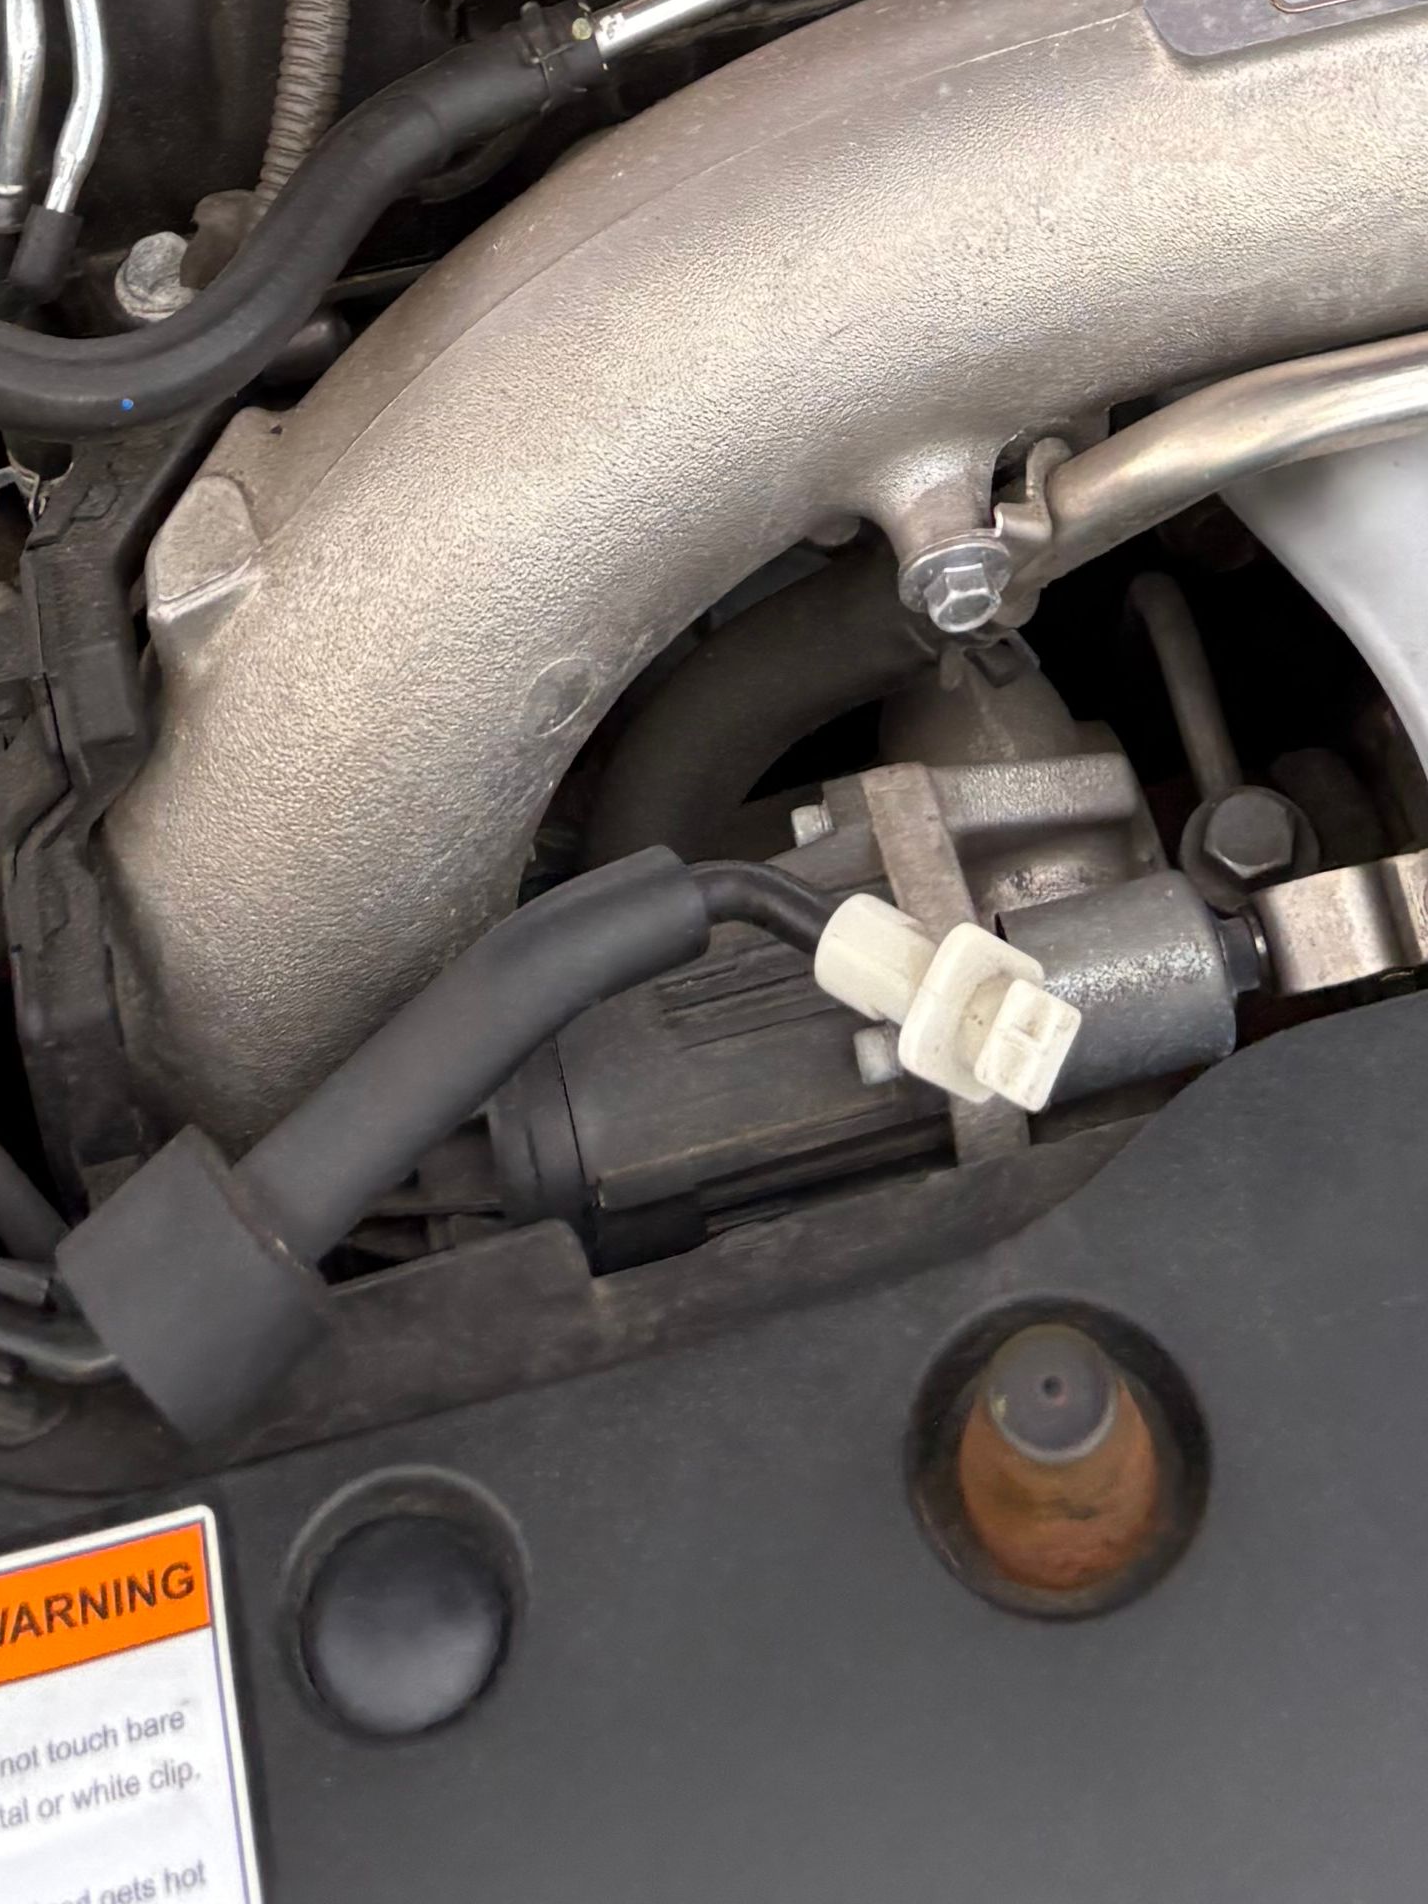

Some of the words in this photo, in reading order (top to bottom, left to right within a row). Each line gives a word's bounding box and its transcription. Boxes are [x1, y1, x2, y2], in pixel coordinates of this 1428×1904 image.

[0, 1747, 40, 1780] not
[47, 1724, 120, 1765] touch
[125, 1710, 186, 1744] bare
[37, 1794, 64, 1820] or
[71, 1774, 141, 1811] white
[148, 1758, 203, 1792] clip.
[164, 1859, 207, 1892] hot
